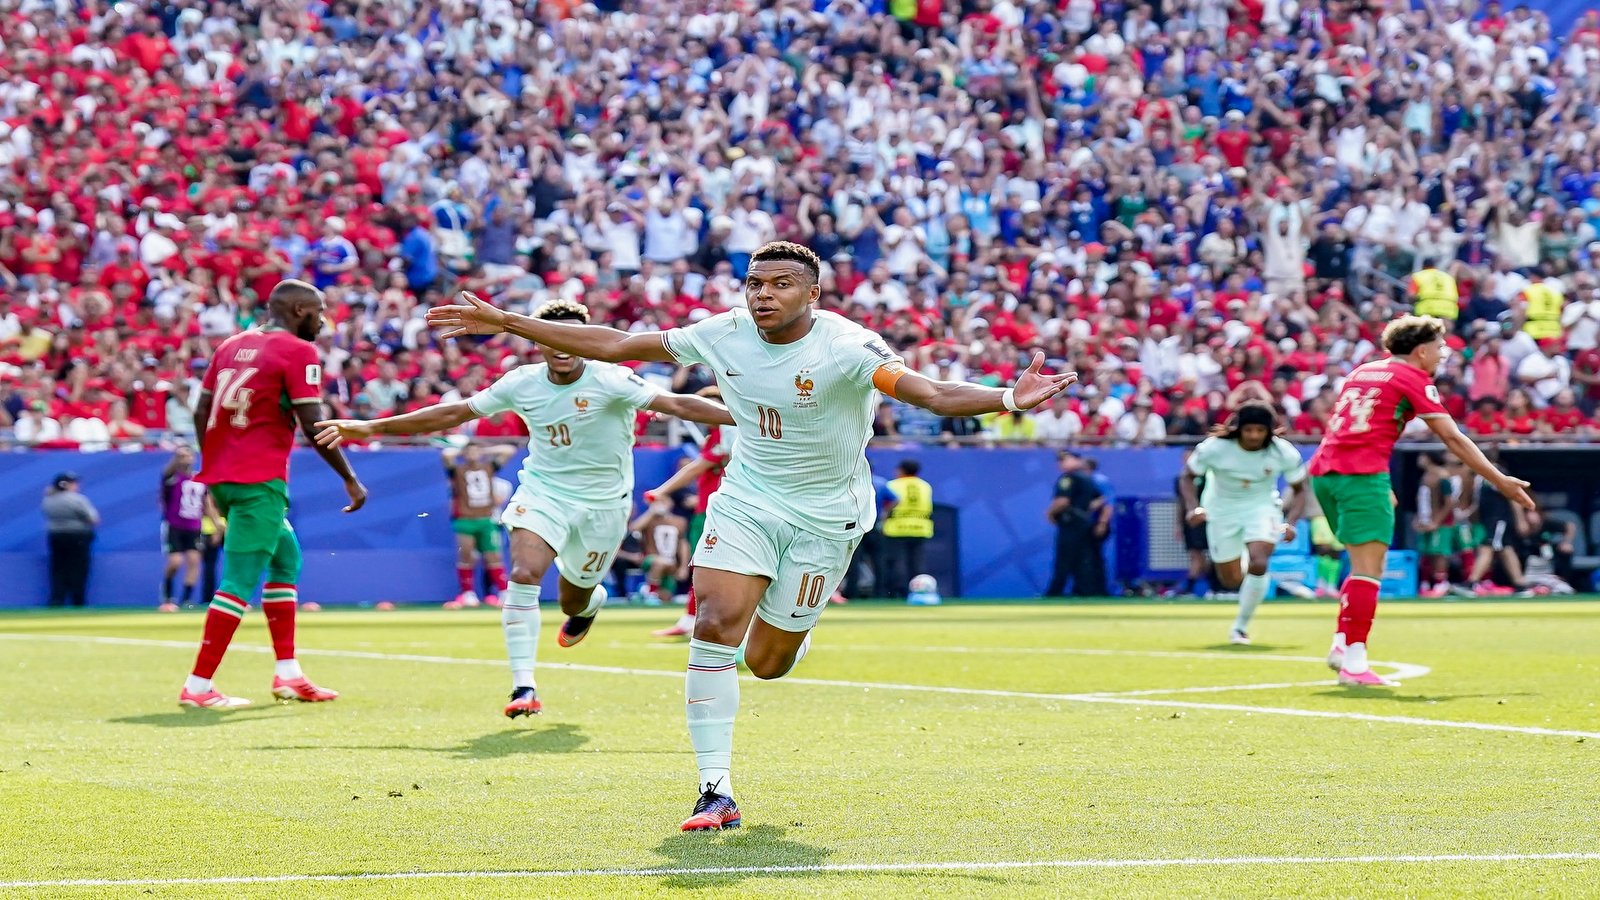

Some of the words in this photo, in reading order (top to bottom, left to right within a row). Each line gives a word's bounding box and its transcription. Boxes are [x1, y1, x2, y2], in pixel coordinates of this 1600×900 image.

[206, 368, 259, 430] 14
[546, 423, 571, 447] 20
[757, 405, 783, 440] 10
[582, 551, 608, 572] 20
[795, 573, 825, 608] 10
